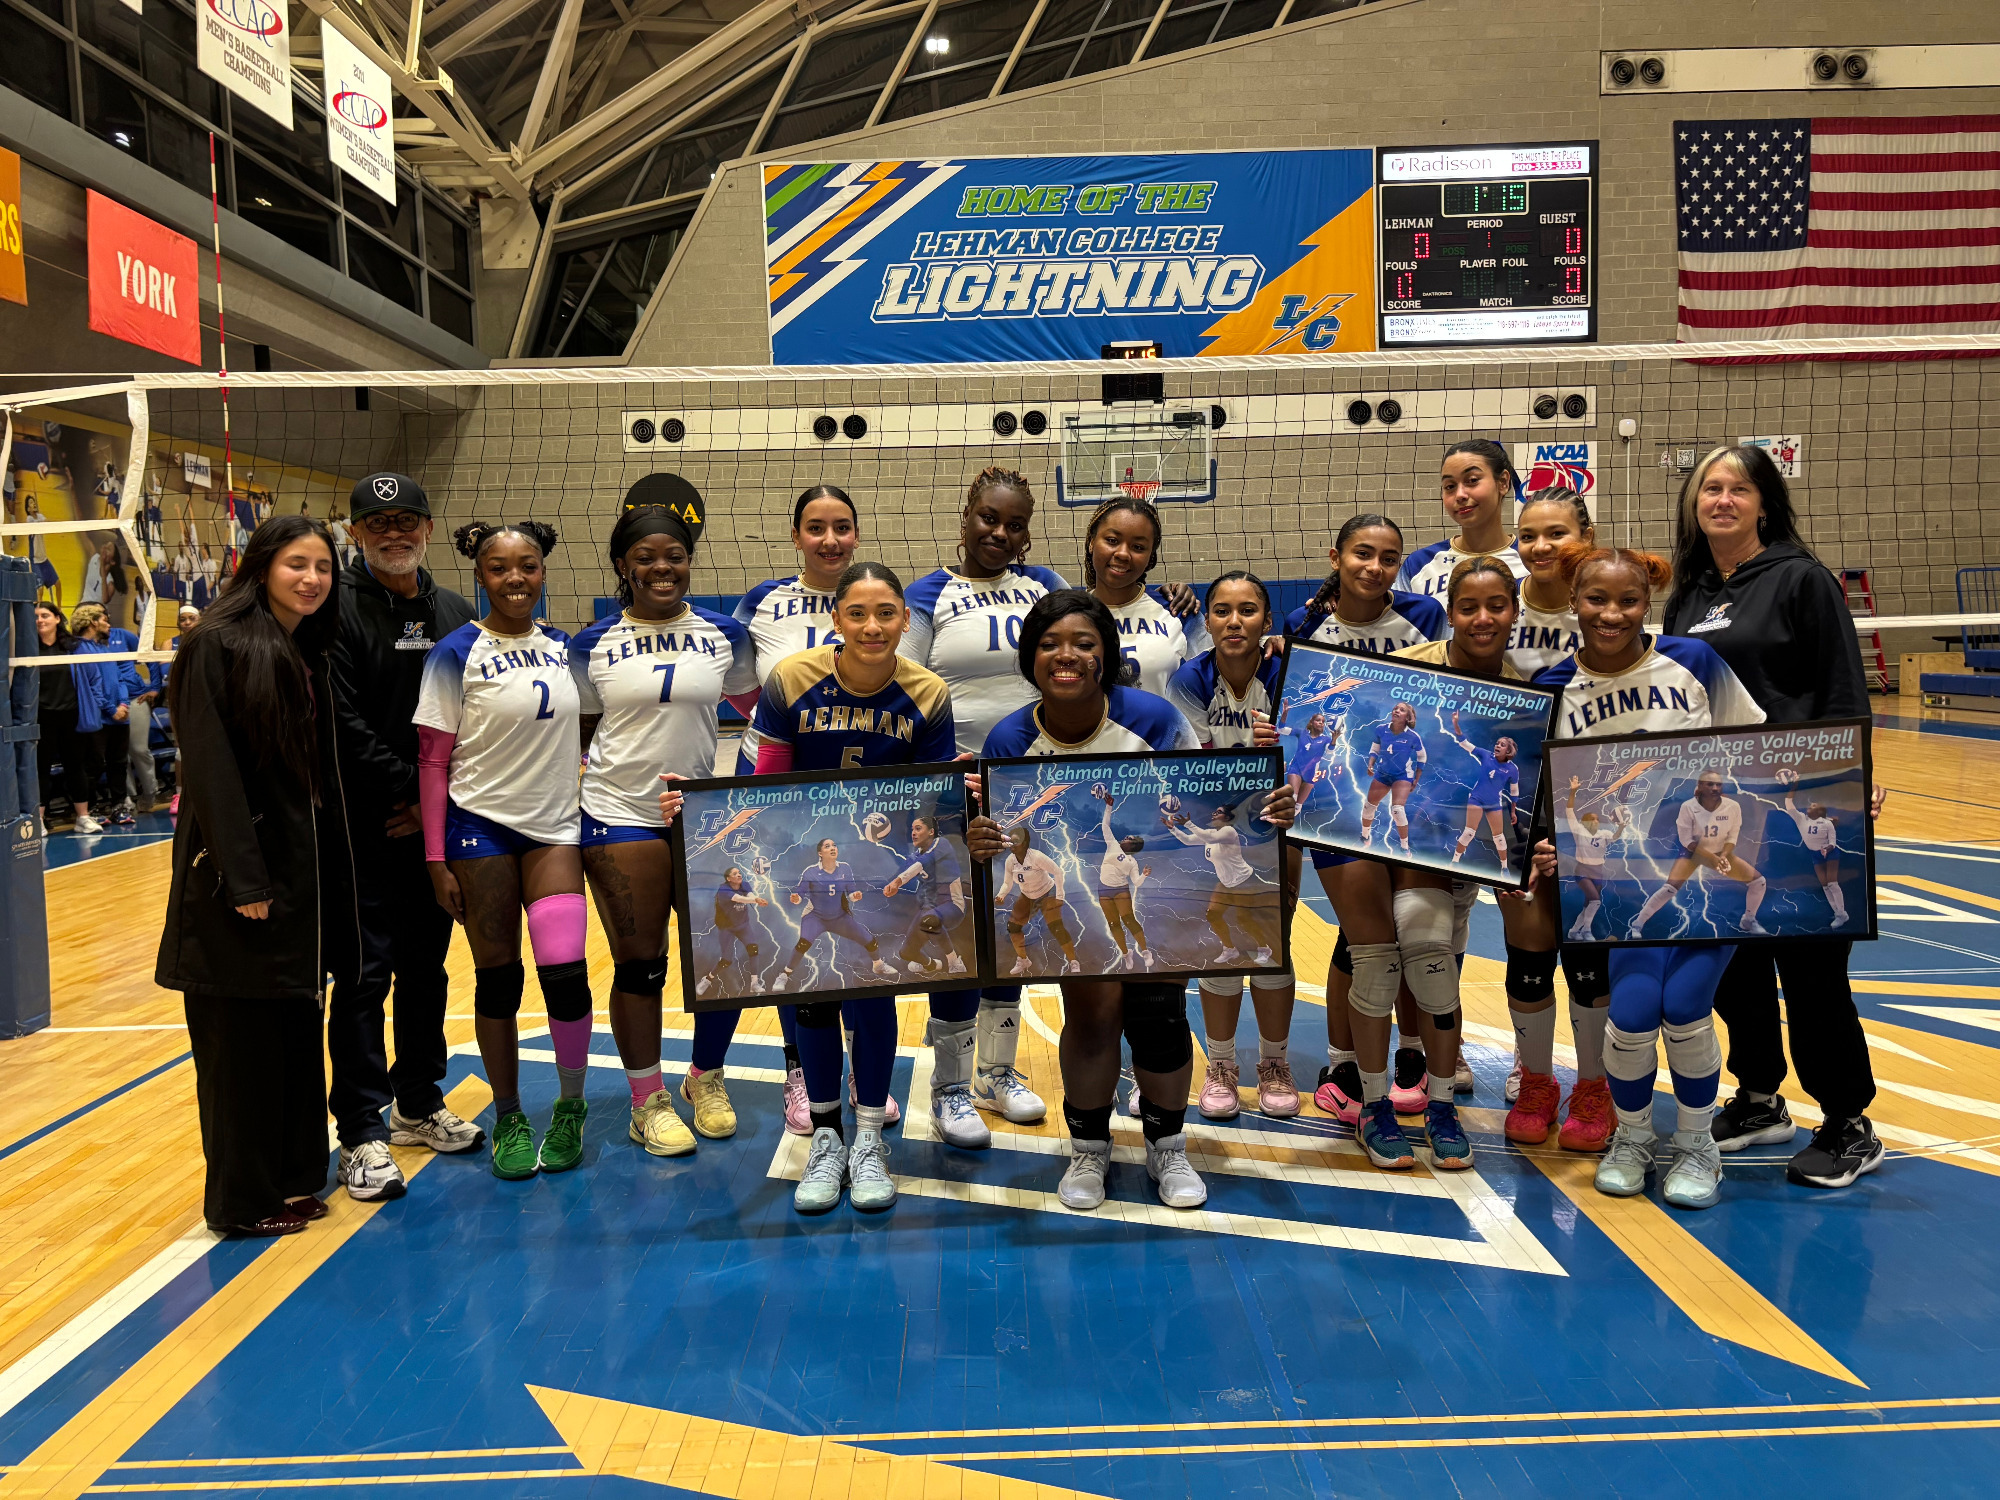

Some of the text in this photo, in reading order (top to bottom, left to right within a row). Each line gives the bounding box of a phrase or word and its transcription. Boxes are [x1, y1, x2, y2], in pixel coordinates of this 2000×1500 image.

[206, 15, 286, 88] MEN'S BASKETBALL
[224, 50, 271, 95] CHAMPIONS
[353, 64, 365, 84] 2011
[340, 79, 381, 139] ECAC
[329, 114, 394, 175] WOMEN'S BASKETBALL
[347, 145, 380, 181] CHAMPIONS
[1409, 156, 1492, 172] Radisson
[1513, 160, 1581, 171] 800-333-3333
[958, 182, 1217, 217] HOME OF THE
[1384, 218, 1434, 229] LEHMAN
[1467, 219, 1503, 228] PERIOD
[1539, 213, 1577, 224] GUEST
[912, 225, 1222, 260] LEHMAN COLLEGE
[1385, 261, 1418, 271] FOULS
[1460, 258, 1528, 269] PLAYER FOUL
[1553, 255, 1586, 265] FOULS
[117, 251, 177, 319] YORK
[871, 254, 1266, 324] LIGHTNING
[1387, 299, 1422, 310] SCORE
[1479, 297, 1513, 307] MATCH
[1552, 295, 1587, 305] SCORE
[1389, 318, 1415, 327] BRONX
[1390, 328, 1415, 337] BRONX
[1535, 444, 1589, 461] NCAA
[773, 596, 836, 622] LEHM
[951, 588, 1041, 617] LEHMAN
[987, 615, 1023, 651] 10
[1117, 617, 1169, 638] MAN
[1505, 626, 1579, 652] EHMA
[607, 633, 717, 667] LEHMAN
[481, 649, 569, 682] LEHMAN
[653, 663, 676, 703] 7
[1342, 661, 1546, 711] Lehman College Volleyball
[532, 680, 554, 720] 2
[1390, 686, 1515, 721] Garyana Altidor
[1568, 686, 1690, 737] LEHMAN
[798, 706, 913, 743] LEHMAN
[1387, 744, 1393, 754] 4
[1611, 729, 1854, 761] Lehman College Volleyball
[1046, 757, 1267, 783] Lehman College Volleyball
[1666, 746, 1854, 772] Cheyenne Gray-Taitt
[1488, 769, 1496, 778] 4
[737, 776, 954, 807] Lehman College Volleyball
[1111, 776, 1275, 796] Elainne Rojas Mesa
[811, 800, 858, 818] Laura
[863, 795, 921, 813] Pinales
[1703, 825, 1719, 838] 13
[1807, 825, 1818, 834] 13
[1117, 853, 1126, 861] 8
[828, 884, 836, 896] 5
[1017, 873, 1025, 883] 8
